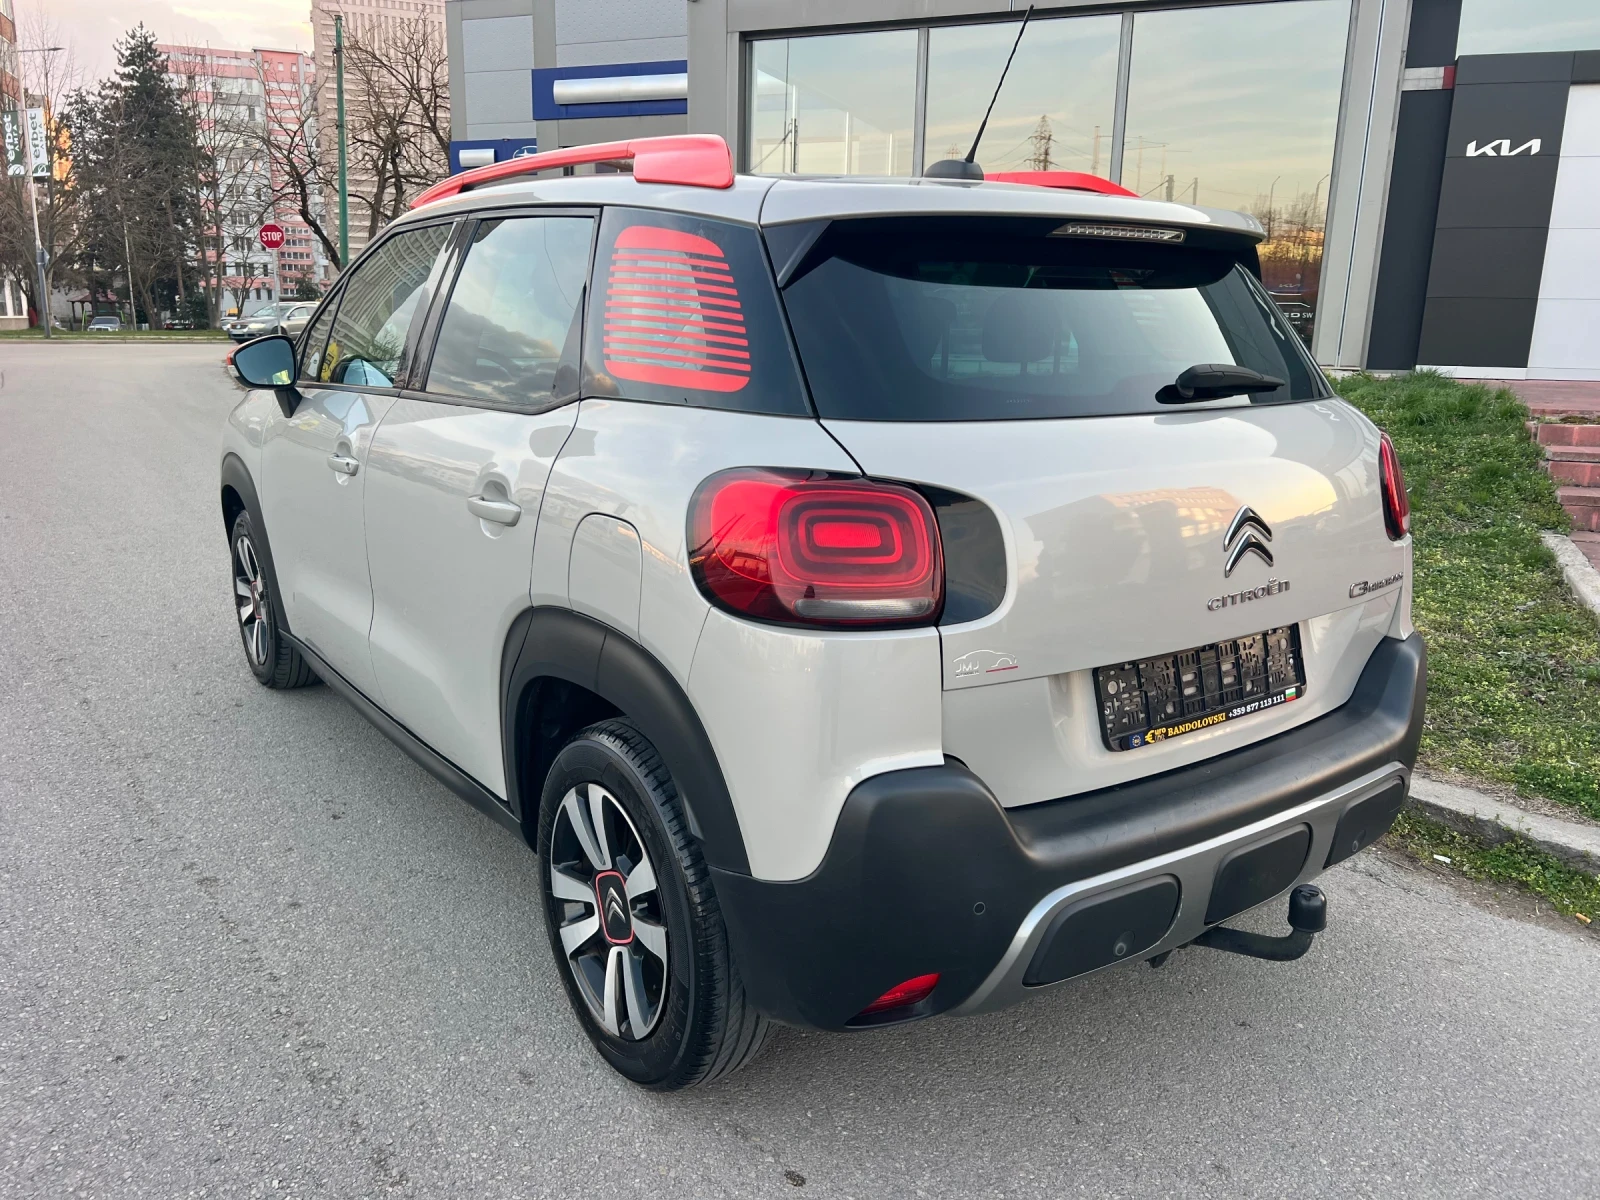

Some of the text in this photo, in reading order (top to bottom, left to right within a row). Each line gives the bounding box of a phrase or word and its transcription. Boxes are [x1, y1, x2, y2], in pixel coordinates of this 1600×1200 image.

[3, 114, 15, 161] efbet
[29, 112, 40, 159] efbet
[1465, 138, 1542, 157] KIA
[261, 231, 282, 241] STOP
[1167, 712, 1227, 737] BANDOLOVSKI
[1228, 706, 1246, 718] +359
[1246, 702, 1259, 713] 877
[1260, 698, 1272, 708] 113
[1273, 694, 1285, 704] 111
